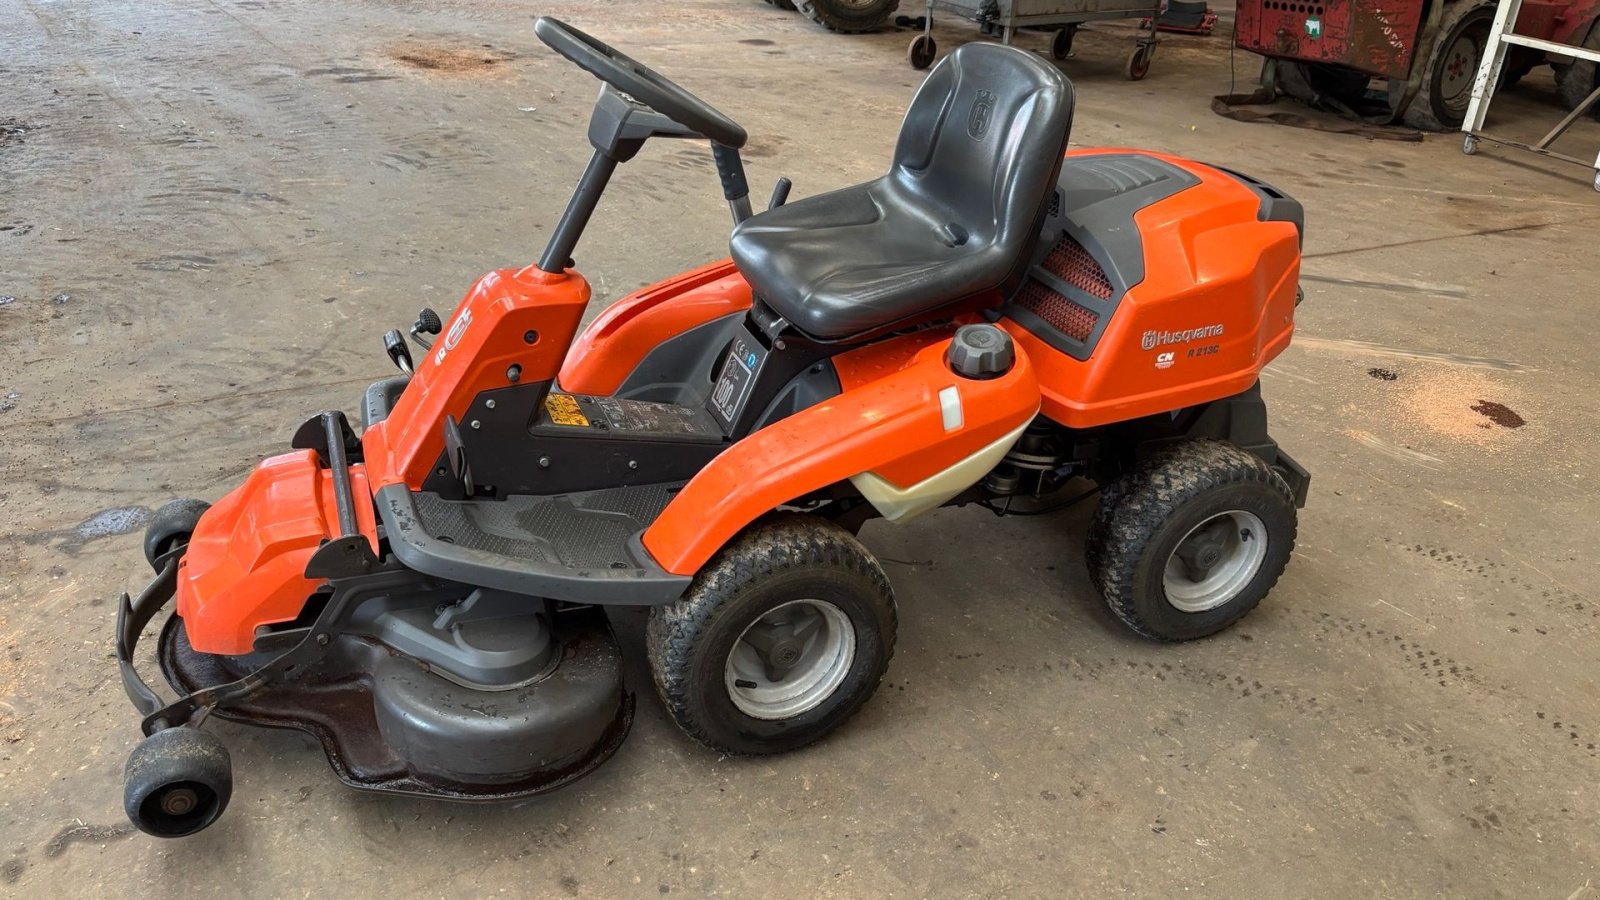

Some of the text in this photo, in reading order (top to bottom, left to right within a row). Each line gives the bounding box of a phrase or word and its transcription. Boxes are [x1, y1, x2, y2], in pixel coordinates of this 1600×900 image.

[1157, 323, 1224, 345] Husqvarna
[1157, 352, 1175, 362] CN
[1187, 345, 1220, 358] R 213C
[716, 377, 735, 409] 100
